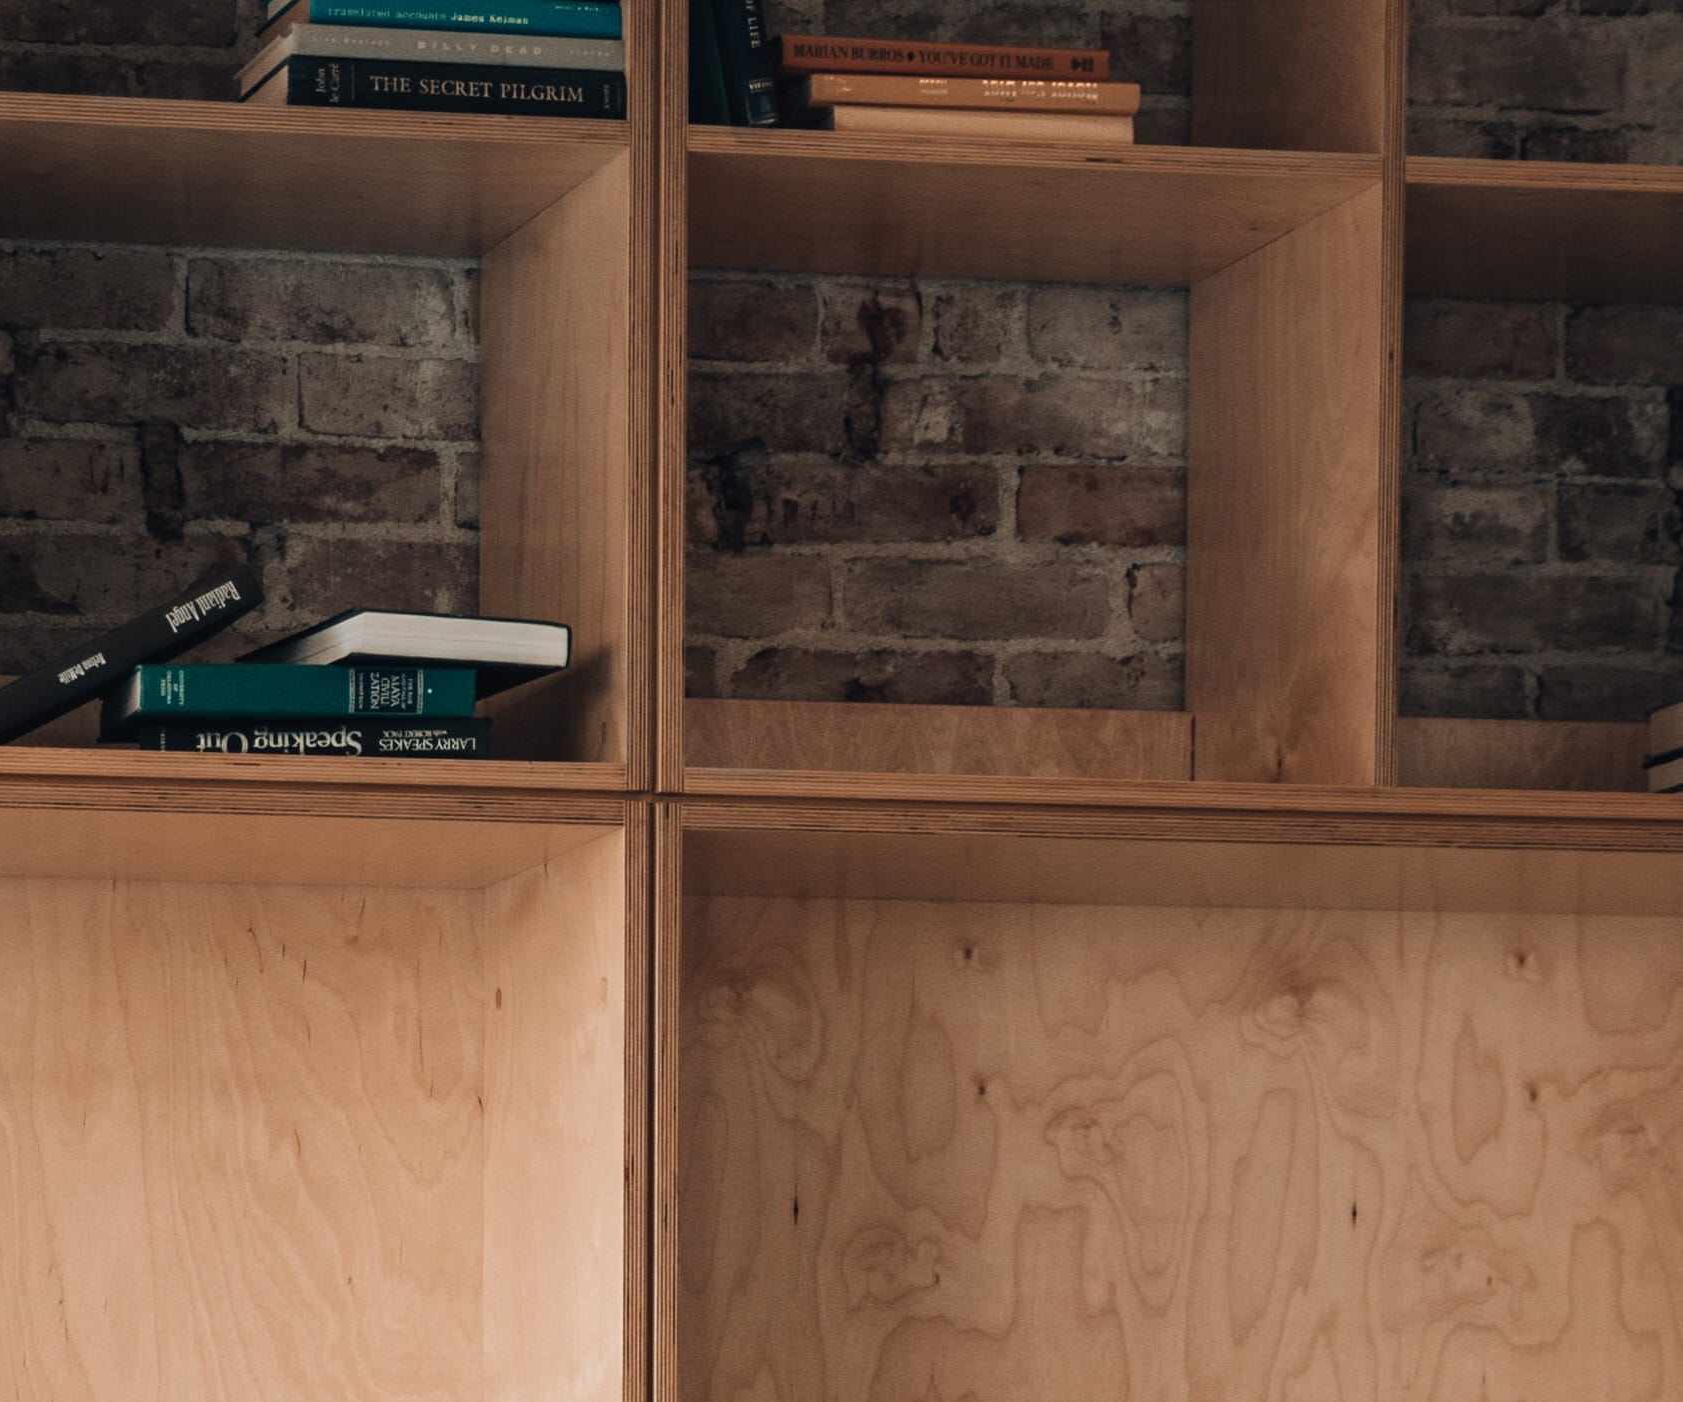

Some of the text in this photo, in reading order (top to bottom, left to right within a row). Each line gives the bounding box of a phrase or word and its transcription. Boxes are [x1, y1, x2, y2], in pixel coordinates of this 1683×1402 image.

[451, 12, 485, 23] James
[489, 14, 529, 25] Kelman
[748, 17, 761, 49] LIFE
[417, 41, 543, 55] BILLY DEAD
[793, 43, 1054, 71] MARIAN BURROS YOU'VE GOT IT MADE
[315, 68, 327, 93] John
[370, 75, 584, 103] THE SECRET PILGRIM
[165, 580, 241, 633] Radiant Angel
[370, 672, 380, 709] ZATION
[390, 675, 401, 707] MAYA
[196, 731, 249, 754] Out
[254, 728, 362, 756] Speaking
[379, 737, 476, 751] LARRY SPEAKES
